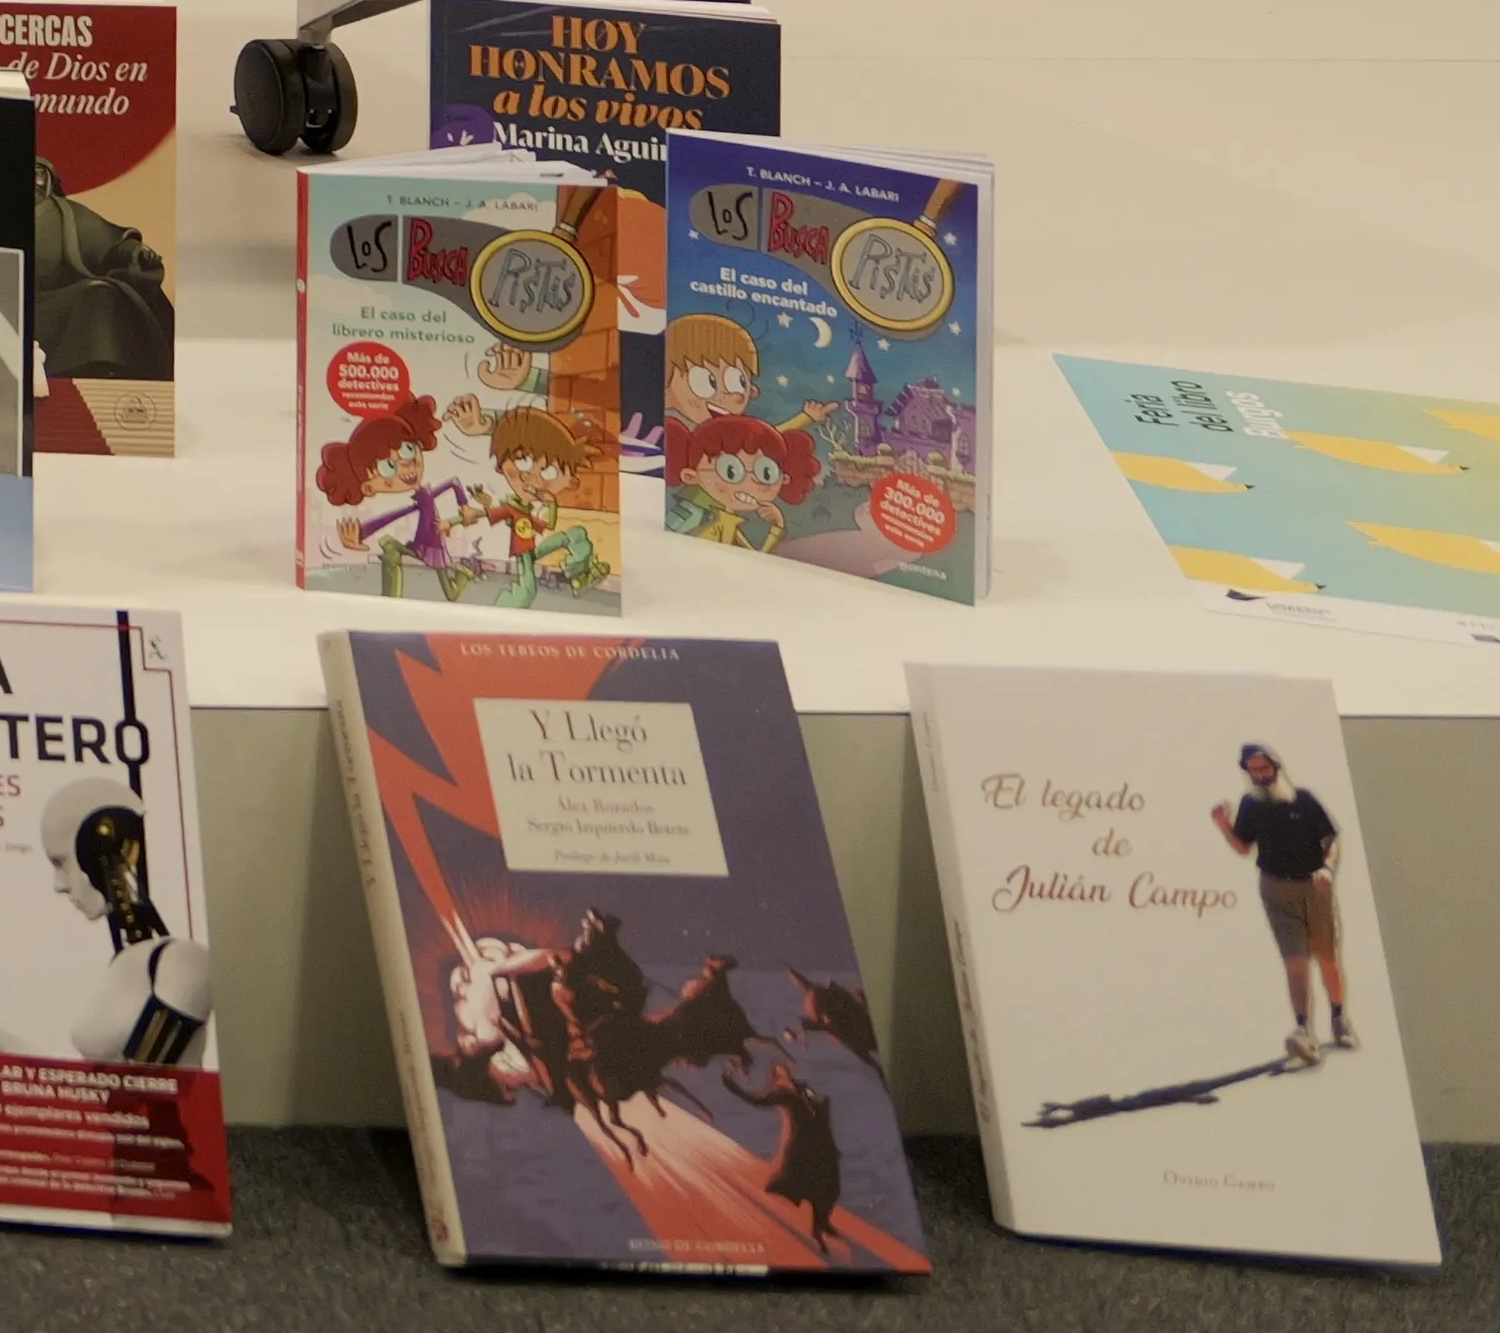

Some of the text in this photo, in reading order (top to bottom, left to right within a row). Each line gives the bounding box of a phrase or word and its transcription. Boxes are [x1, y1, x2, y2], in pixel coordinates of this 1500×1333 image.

[551, 15, 647, 55] HOY
[8, 51, 40, 80] de
[44, 51, 110, 82] Dios
[115, 62, 148, 82] en
[469, 44, 732, 100] HONRAMOS
[34, 87, 131, 116] mundo
[492, 83, 704, 131] a los vivos
[690, 280, 838, 318] castillo encantado
[719, 267, 808, 296] El caso del
[360, 306, 447, 324] El caso del
[338, 363, 399, 380] 500.000
[528, 709, 649, 753] Y Llegó
[505, 749, 689, 786] la Tormenta
[981, 772, 1147, 821] El legado
[1091, 828, 1134, 859] de
[991, 864, 1240, 919] Julián Campo
[1, 1079, 57, 1101] BRUNA
[57, 1085, 112, 1107] HUSKY
